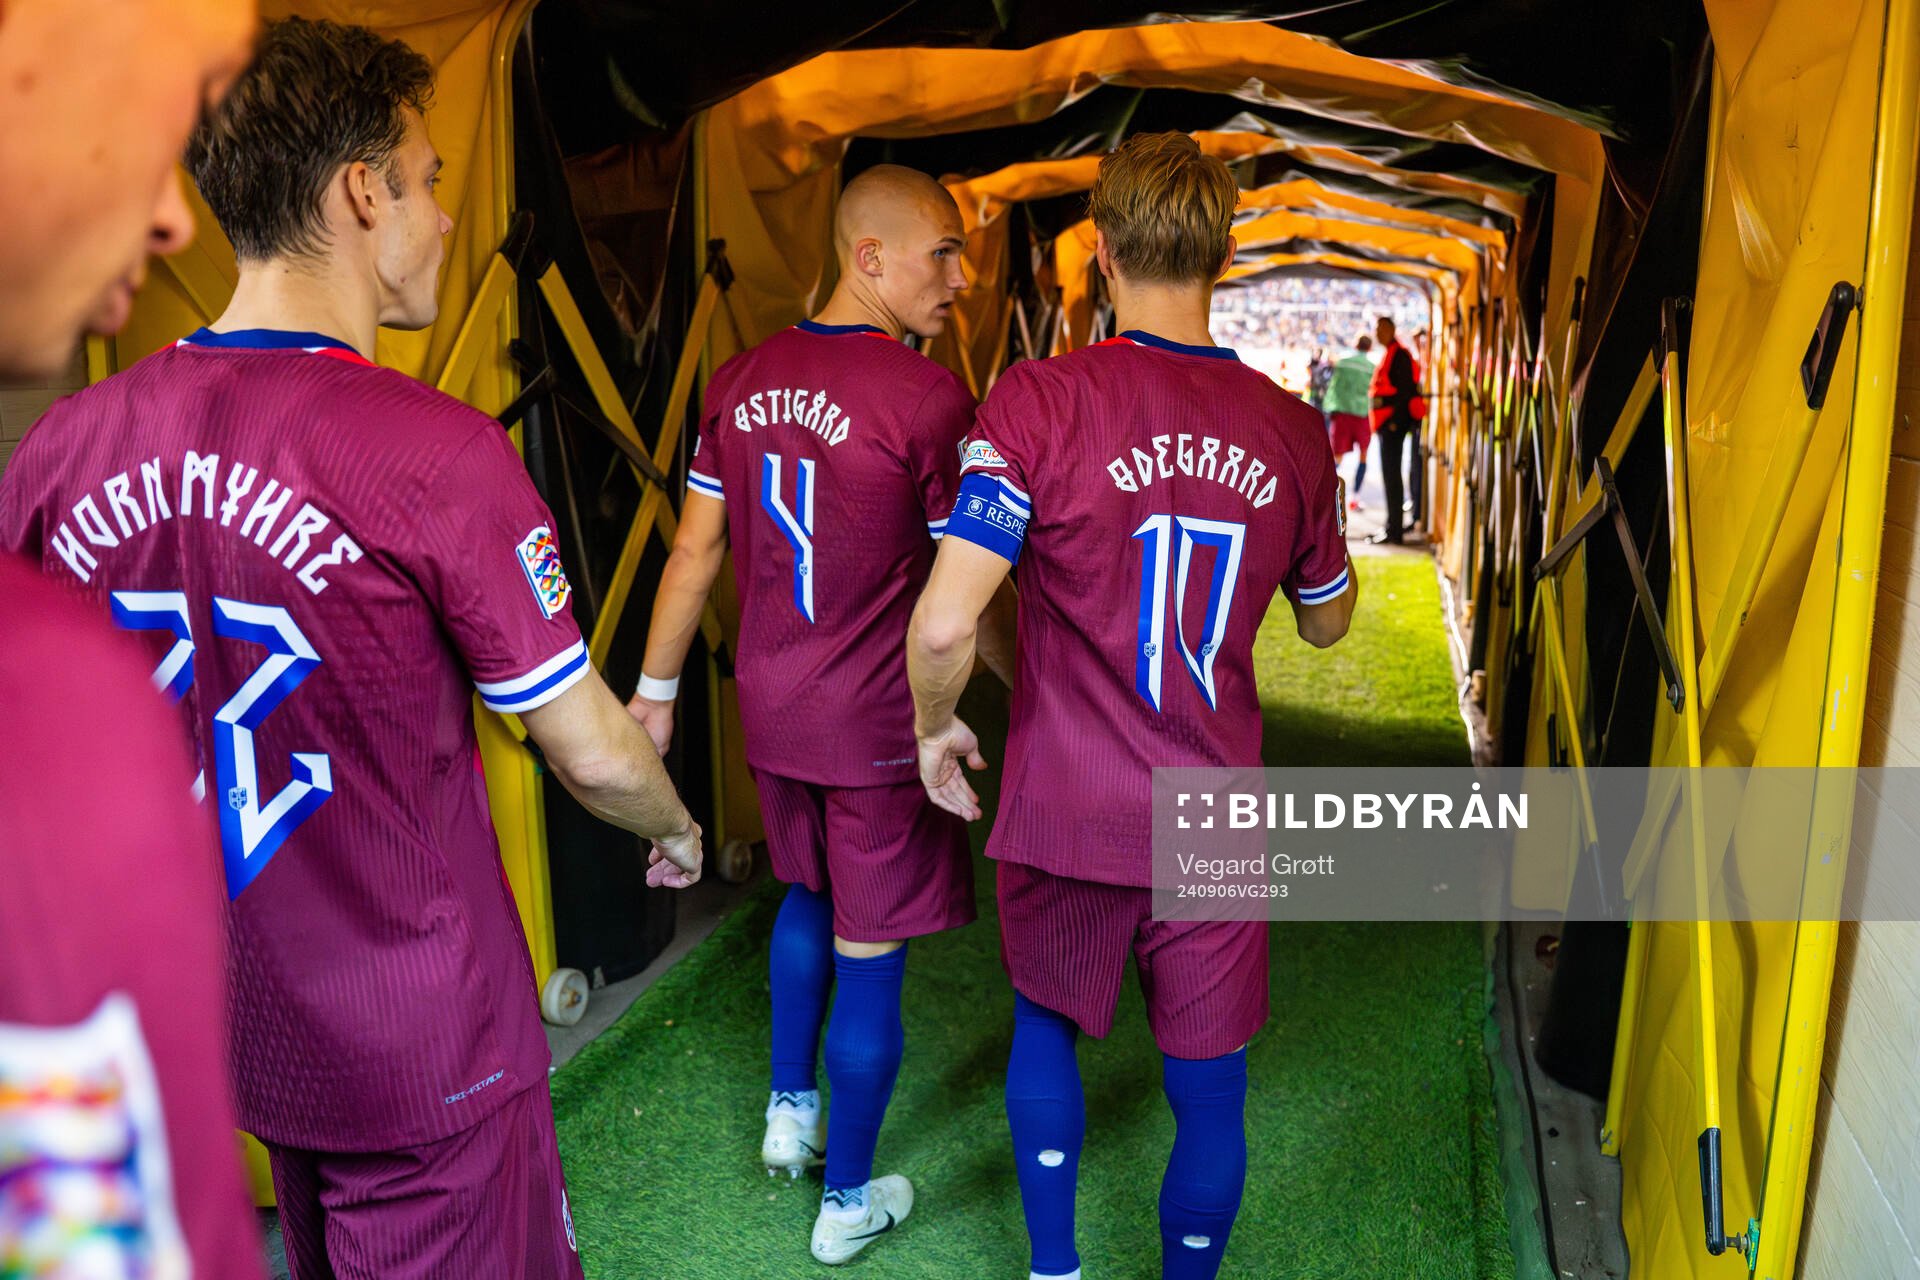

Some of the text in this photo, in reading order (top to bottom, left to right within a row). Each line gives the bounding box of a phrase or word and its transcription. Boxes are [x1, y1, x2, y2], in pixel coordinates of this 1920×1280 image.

[734, 387, 851, 447] ØSTIGÅRD
[1106, 433, 1279, 509] ØDEGAARD
[51, 450, 364, 595] HORN MYHRE
[760, 452, 816, 625] 4
[986, 506, 1027, 537] RESPEC
[1131, 513, 1247, 714] 10
